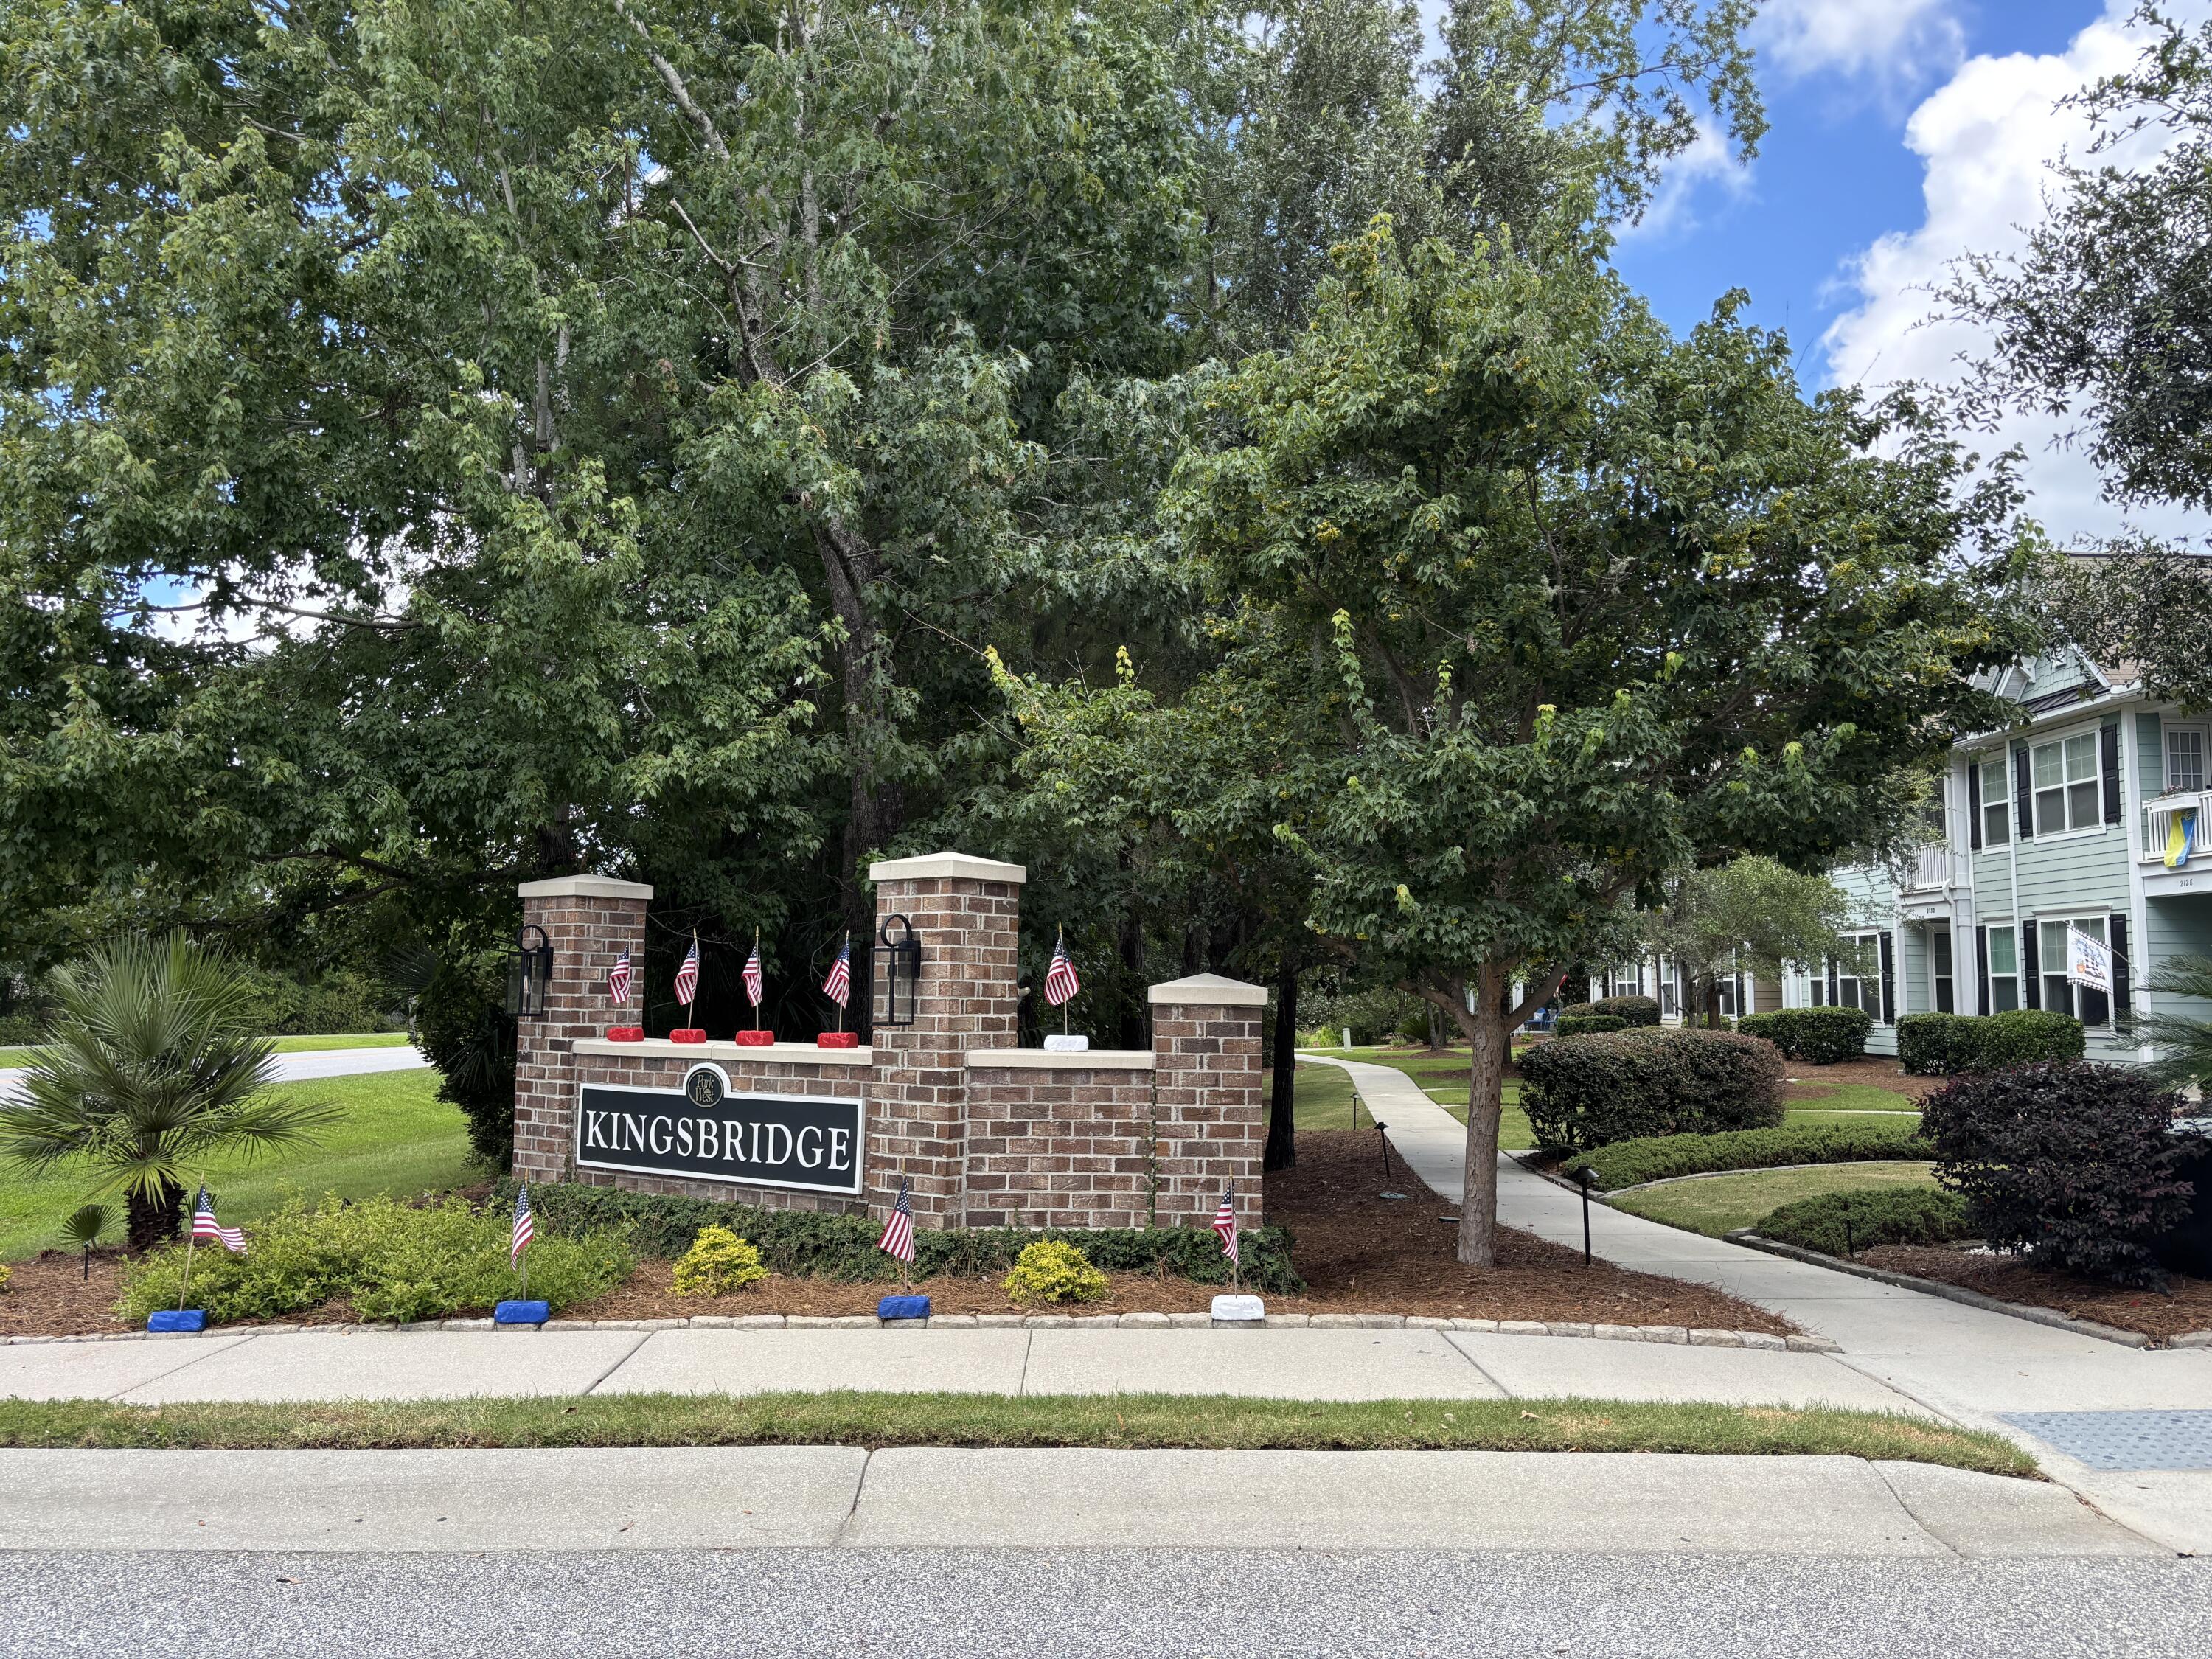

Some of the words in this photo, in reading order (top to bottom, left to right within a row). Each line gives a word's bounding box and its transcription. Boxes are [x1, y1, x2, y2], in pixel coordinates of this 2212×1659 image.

[698, 1074, 714, 1088] Park
[695, 1087, 714, 1102] West
[585, 1110, 850, 1171] KINGSBRIDGE
